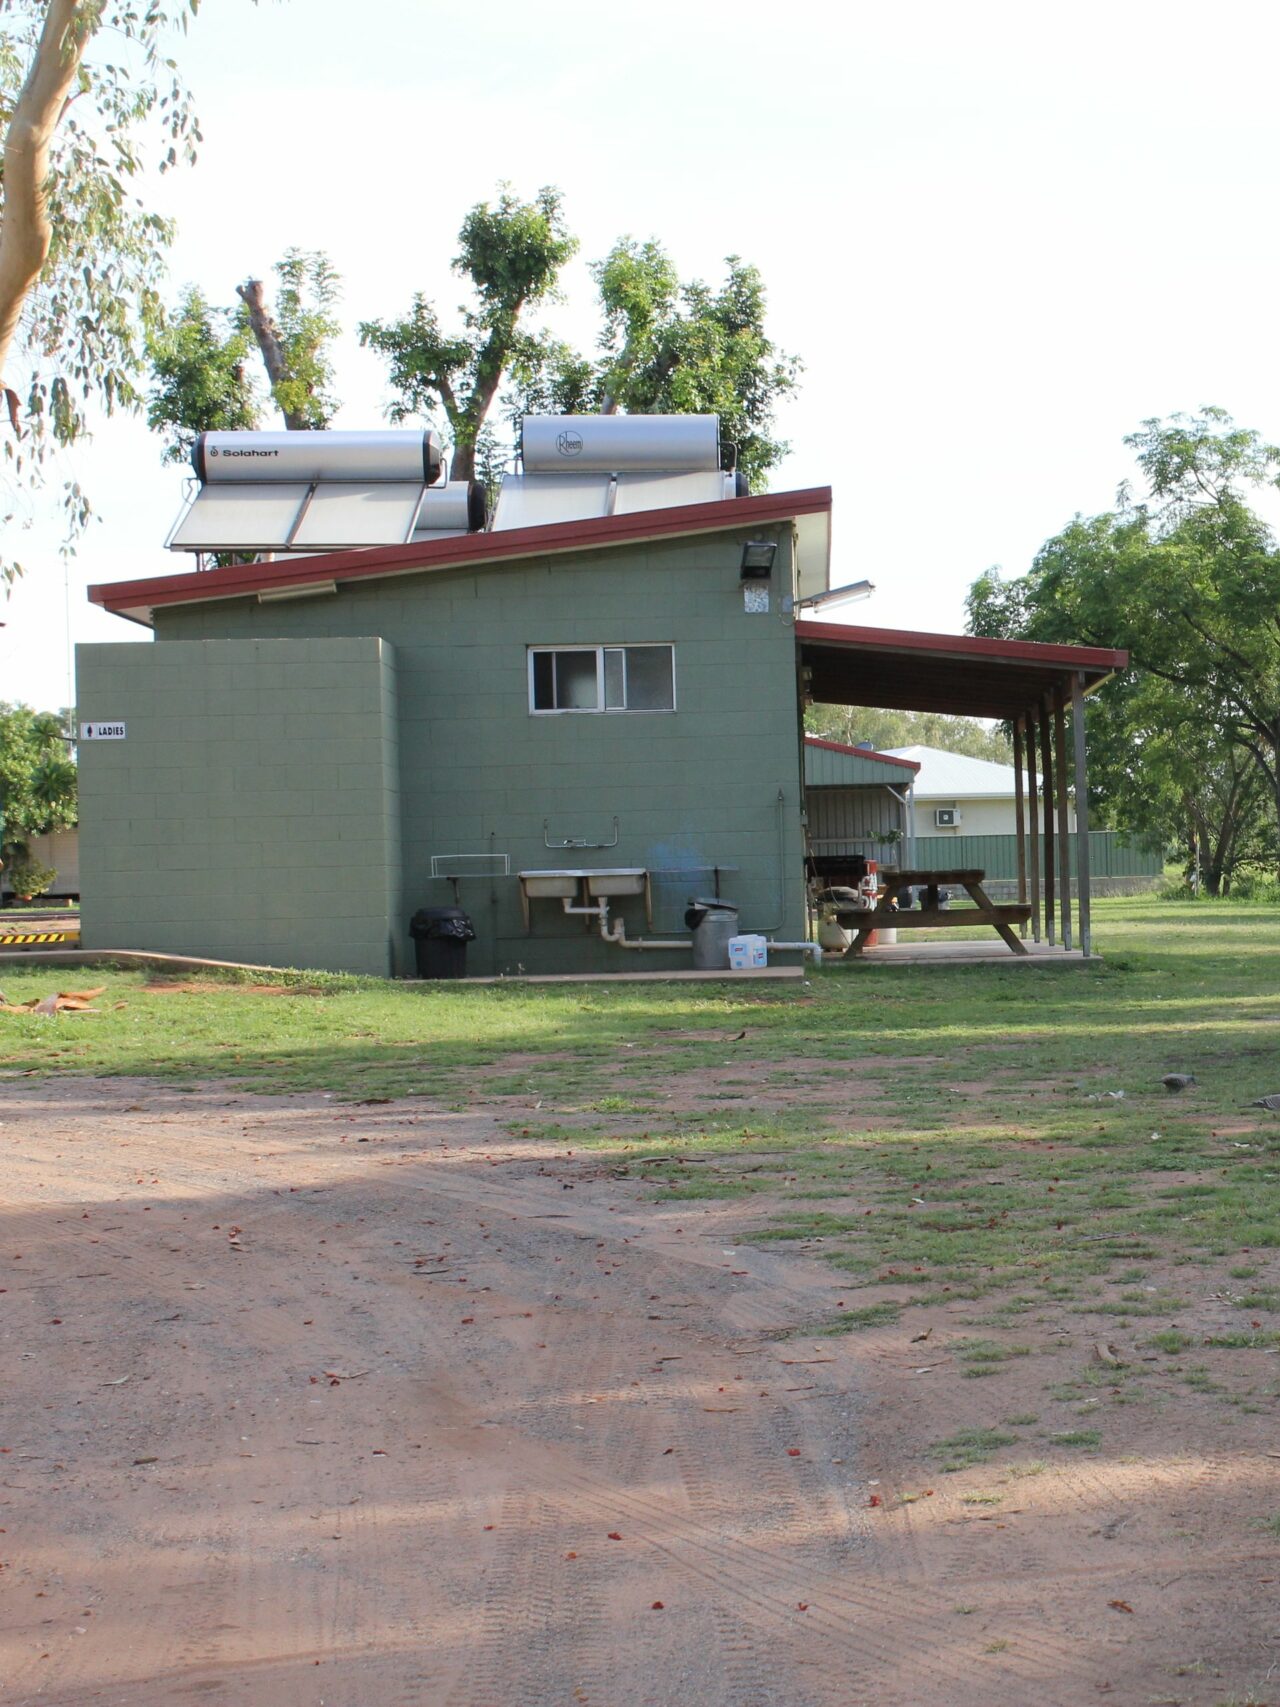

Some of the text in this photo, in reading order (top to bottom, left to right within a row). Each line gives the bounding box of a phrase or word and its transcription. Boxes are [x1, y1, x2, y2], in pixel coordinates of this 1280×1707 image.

[559, 431, 583, 453] Rheem
[222, 449, 280, 457] Solahart
[98, 726, 124, 736] LADIES
